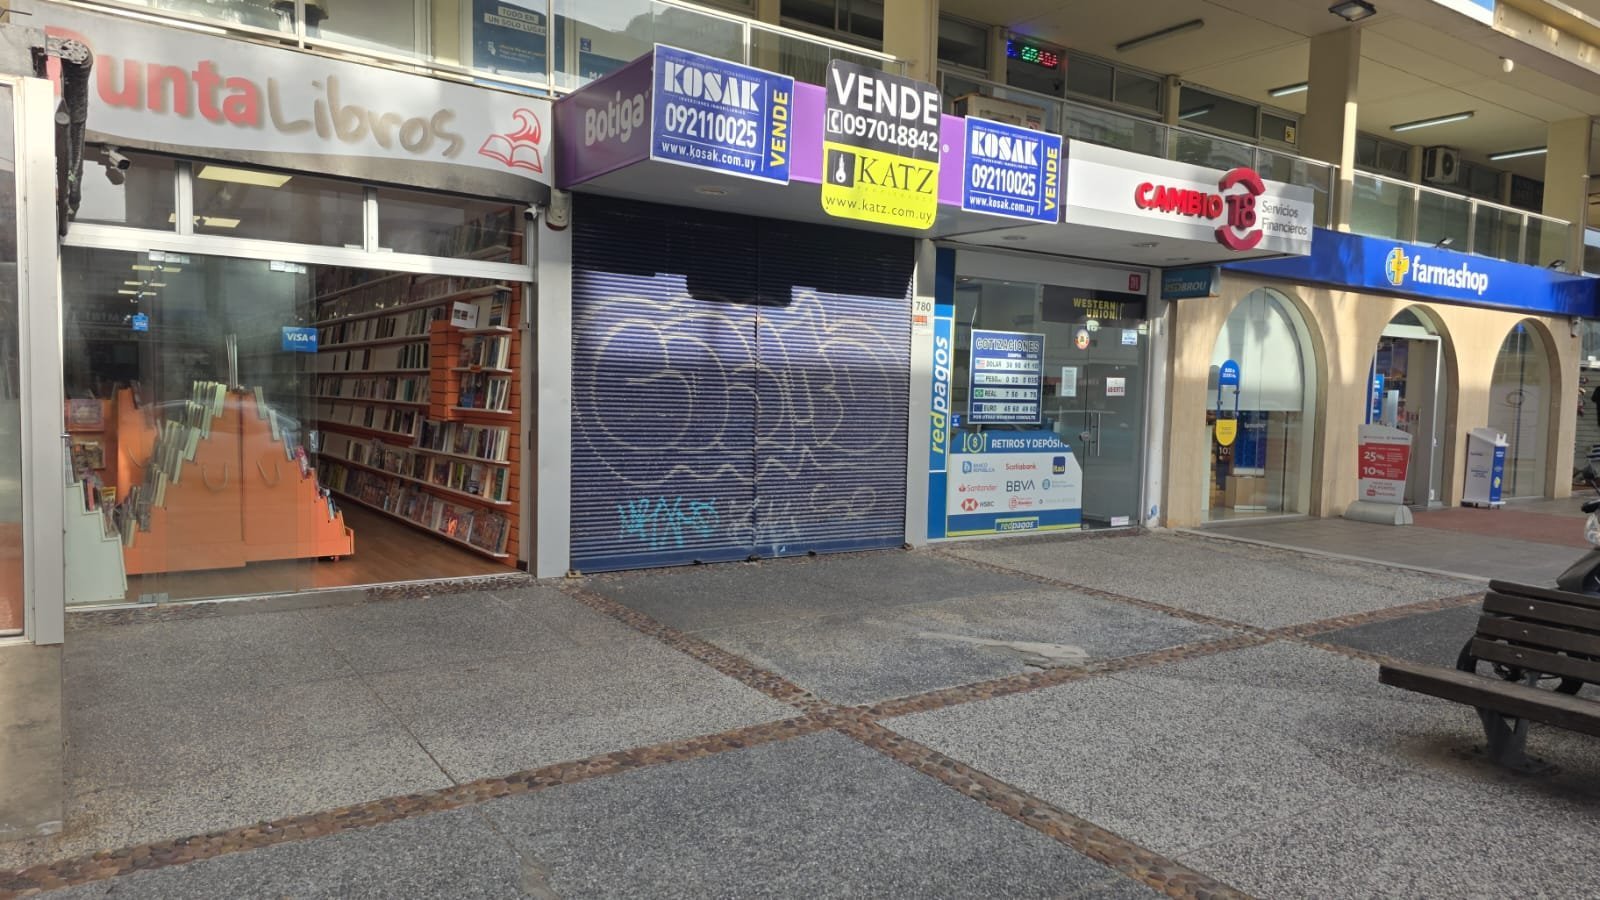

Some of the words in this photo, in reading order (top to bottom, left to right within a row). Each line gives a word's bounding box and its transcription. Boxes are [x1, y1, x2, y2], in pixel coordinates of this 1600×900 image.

[488, 15, 500, 24] UN
[501, 19, 521, 28] SOLO
[502, 8, 523, 19] TODO
[524, 13, 536, 22] EN
[664, 61, 760, 112] KOSAK
[831, 67, 939, 127] VENDE
[585, 90, 645, 146] Botiga
[665, 103, 757, 148] 092110025
[769, 89, 788, 168] VENDE
[843, 113, 939, 153] 097018842
[661, 140, 756, 171] www.kosak.com.uy
[971, 129, 1039, 166] KOSAK
[856, 155, 934, 195] KATZ
[971, 164, 1036, 197] 092110025
[1044, 146, 1058, 211] VENDE
[825, 195, 933, 223] www.katz.com.uy
[969, 195, 1035, 215] www.kosak.com.uy
[1134, 182, 1223, 220] CAMBIO
[1225, 192, 1257, 231] 18
[1261, 200, 1298, 218] Servicios
[1261, 217, 1308, 235] Financieros
[1412, 255, 1488, 296] farmashop
[915, 301, 932, 312] 780
[1072, 298, 1117, 310] WESTERN
[1086, 308, 1117, 320] UNION
[286, 332, 308, 342] VISA
[975, 337, 1040, 352] COTIZACIONES
[929, 335, 950, 454] redpagos
[991, 439, 1025, 449] RETIROS
[1026, 439, 1032, 448] Y
[967, 484, 997, 492] Santander
[1006, 480, 1036, 492] BBVA
[1000, 521, 1034, 531] redpagos
